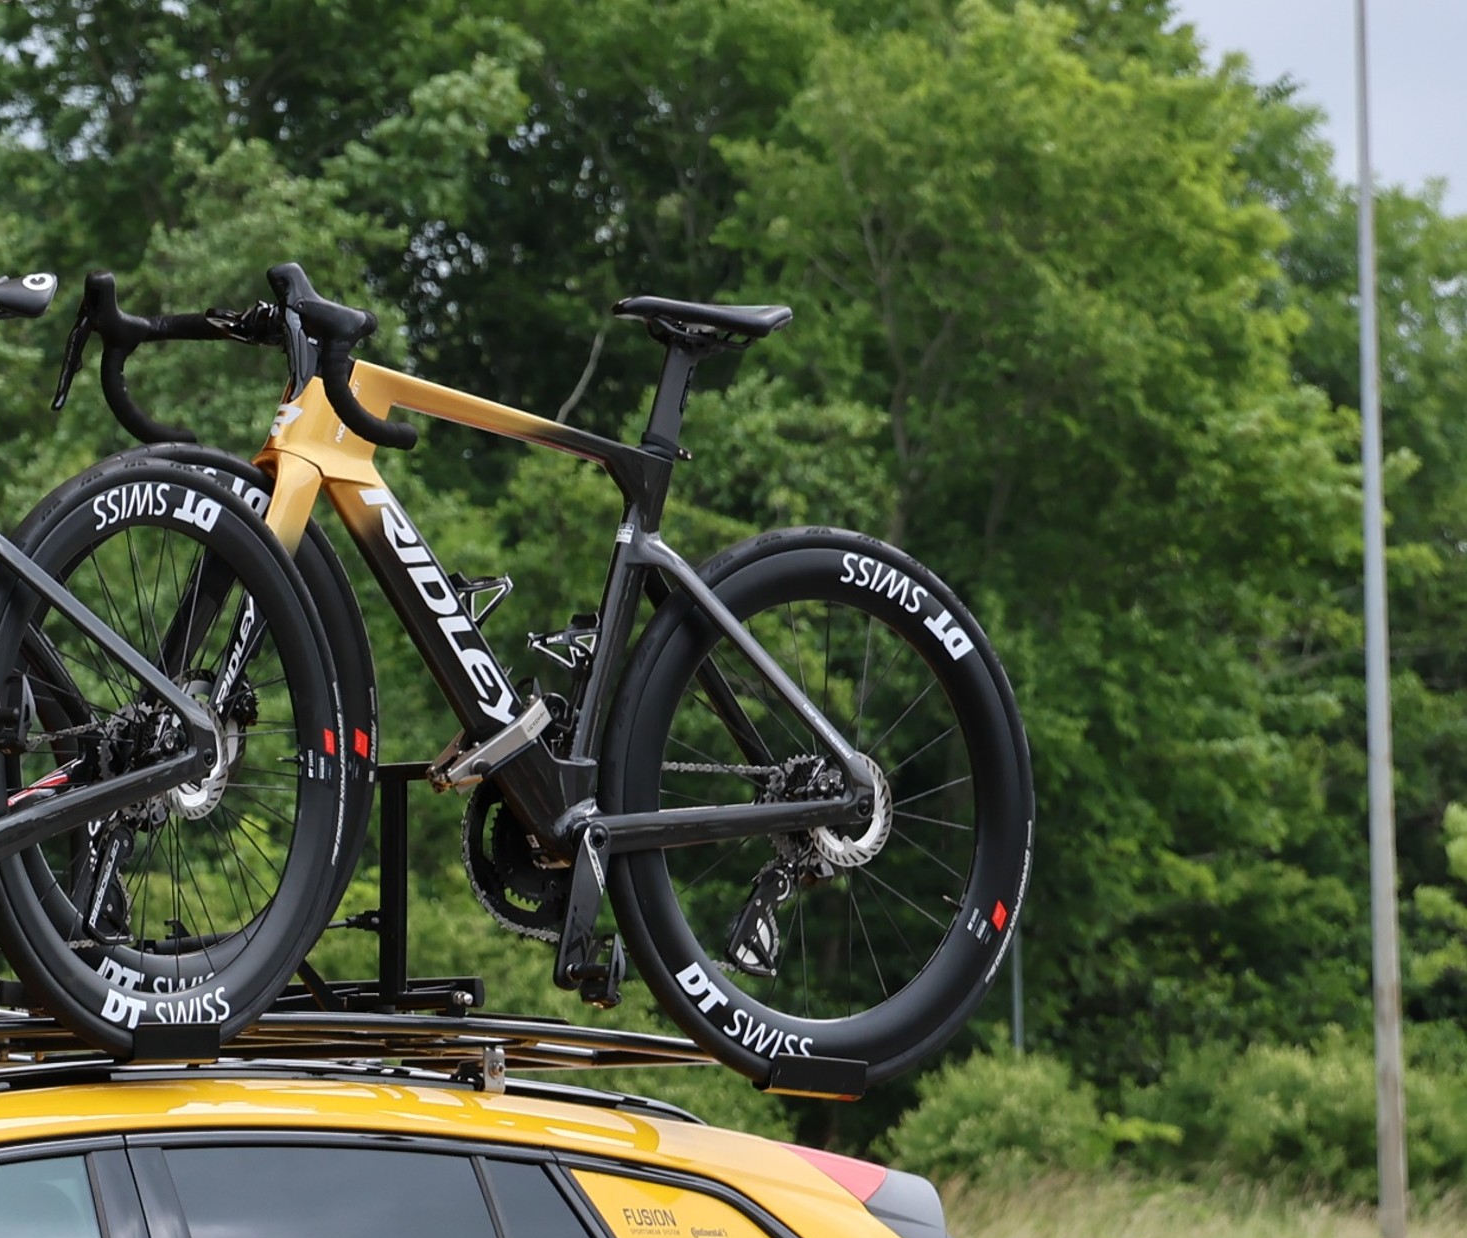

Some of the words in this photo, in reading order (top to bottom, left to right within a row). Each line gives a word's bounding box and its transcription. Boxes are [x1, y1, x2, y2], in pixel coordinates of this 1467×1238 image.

[93, 483, 171, 531] SWISS
[172, 491, 223, 533] DT
[360, 488, 518, 725] RIDLEY
[840, 551, 930, 615] SWISS
[923, 602, 976, 662] DT
[100, 988, 147, 1030] DT
[154, 986, 231, 1024] SWISS
[675, 961, 730, 1014] DT
[623, 1208, 677, 1227] FUSION
